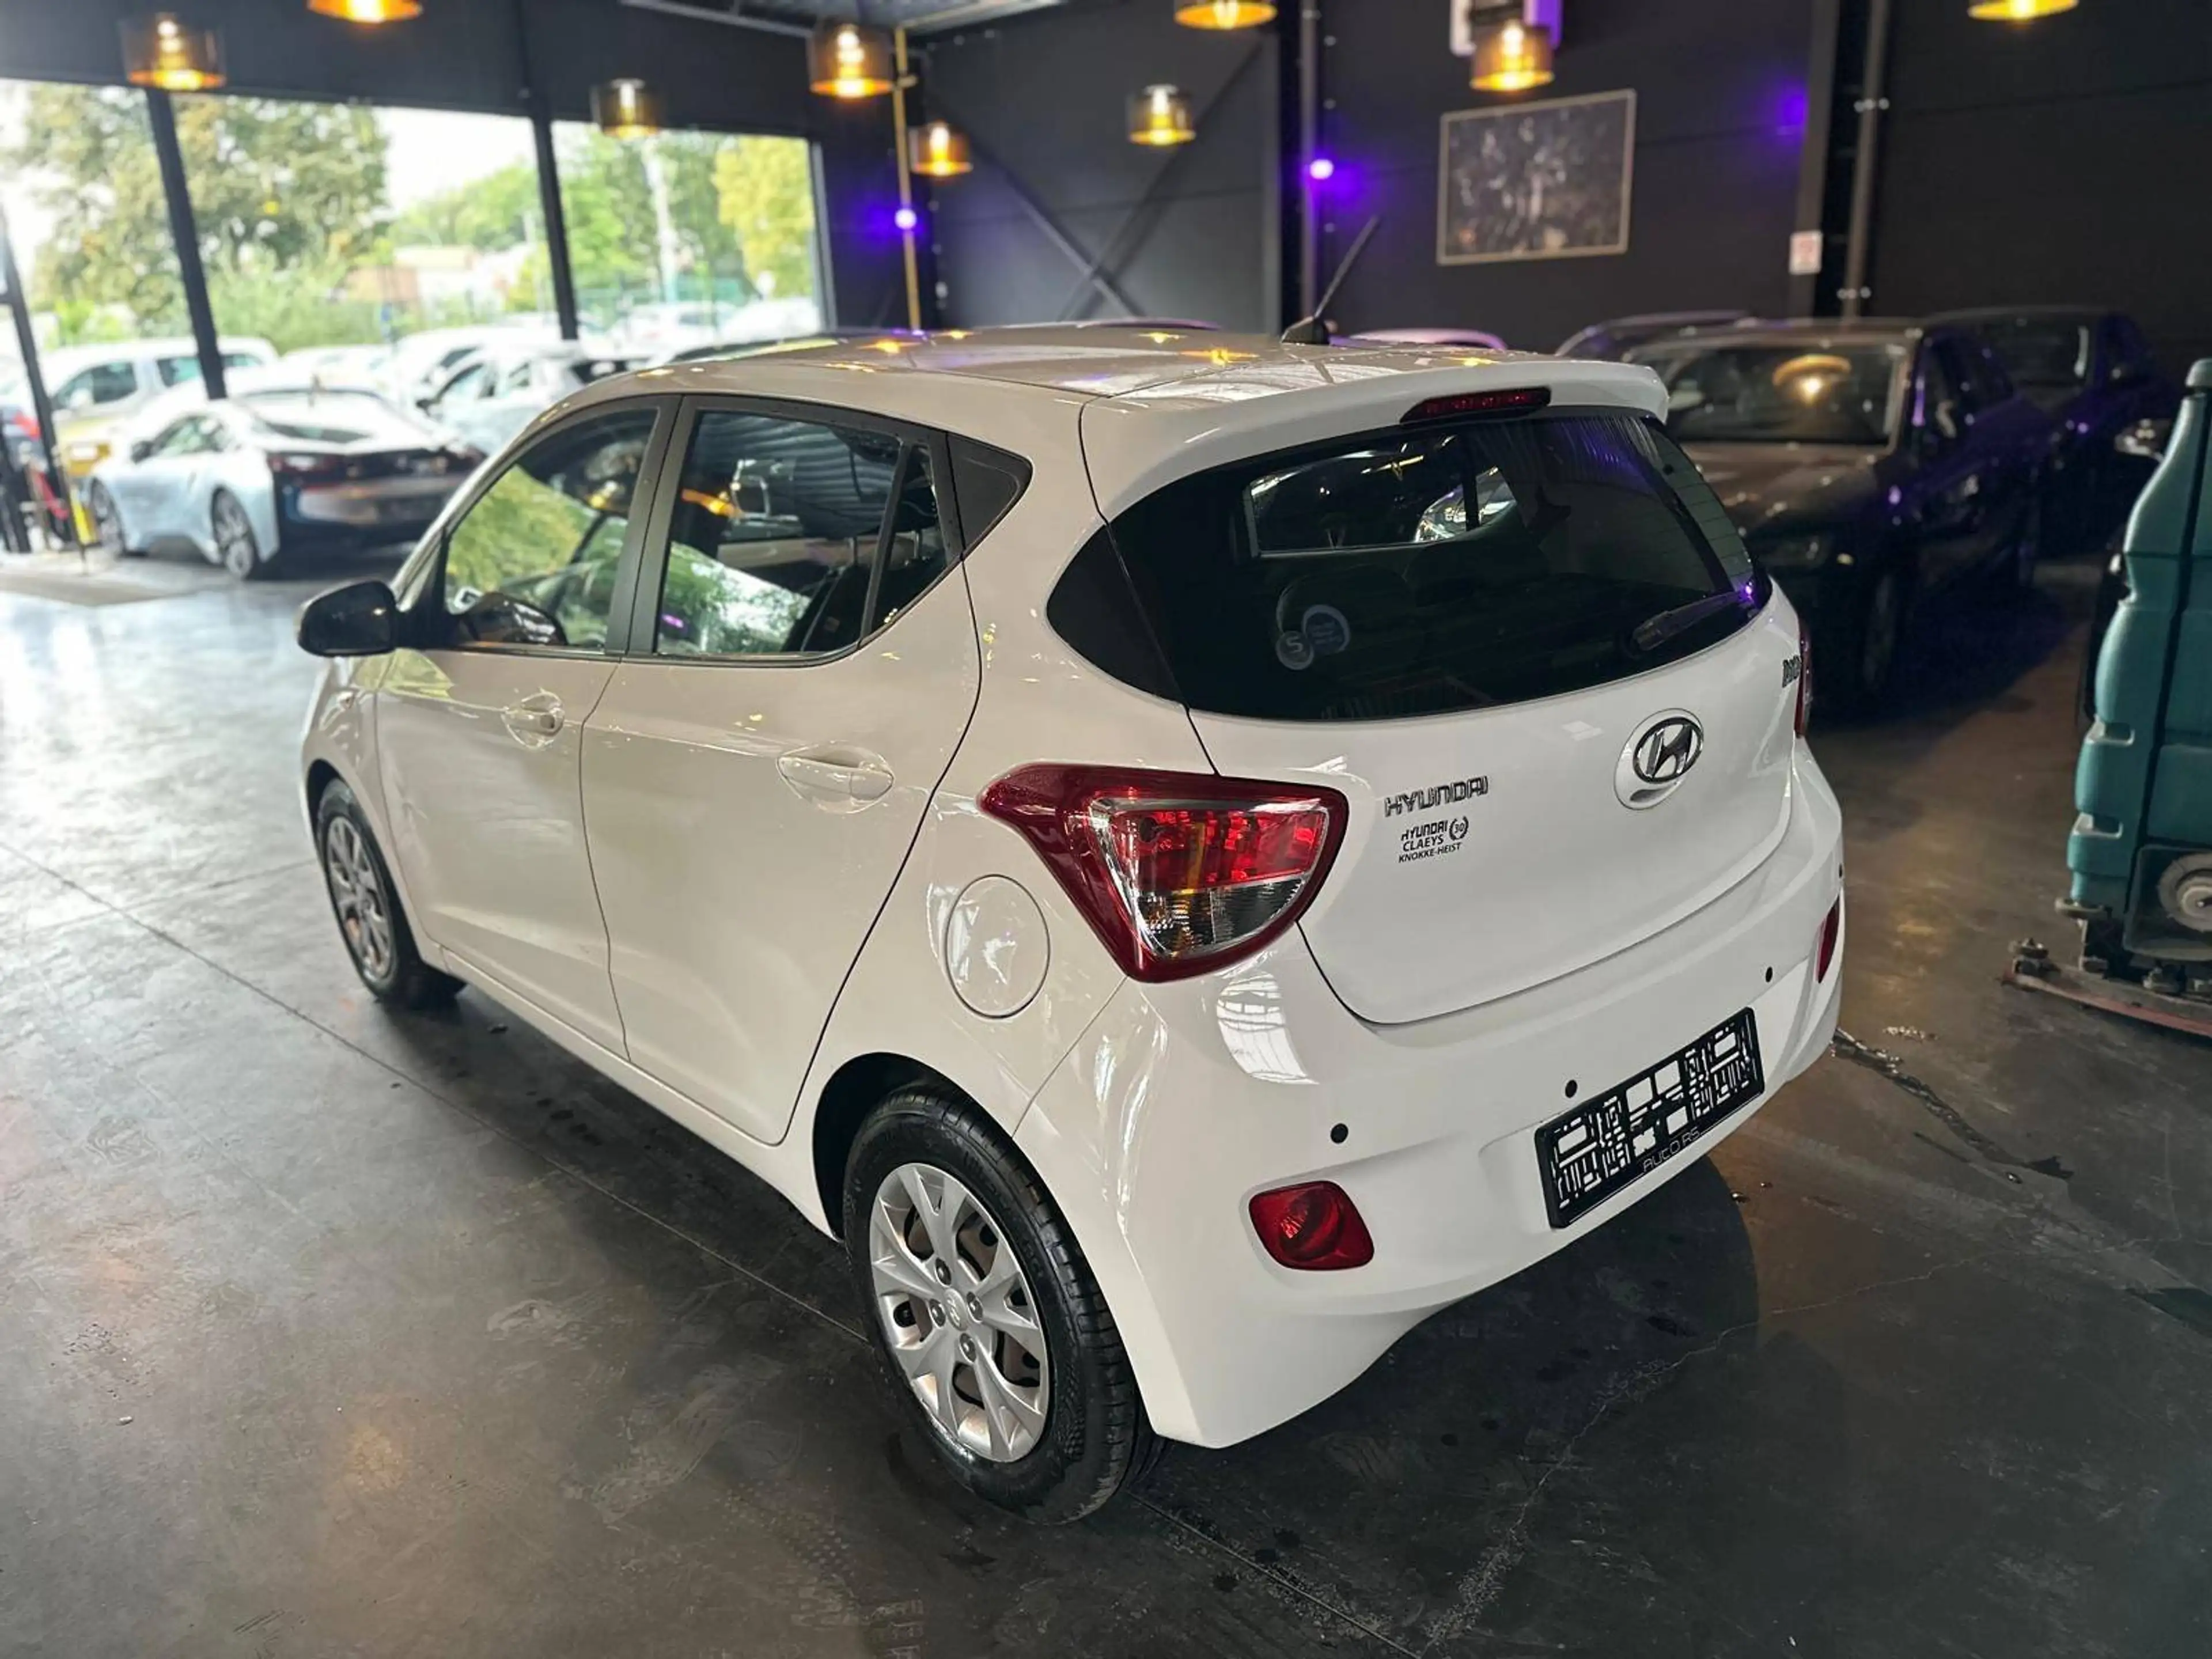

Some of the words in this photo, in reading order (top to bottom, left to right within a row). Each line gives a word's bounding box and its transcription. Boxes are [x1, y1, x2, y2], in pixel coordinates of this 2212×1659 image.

[1384, 775, 1488, 817] HYUNDAI
[1400, 820, 1448, 841] HYUNDAI
[1399, 842, 1461, 862] KNOKKE-HEIST
[1403, 834, 1444, 851] CLAEYS
